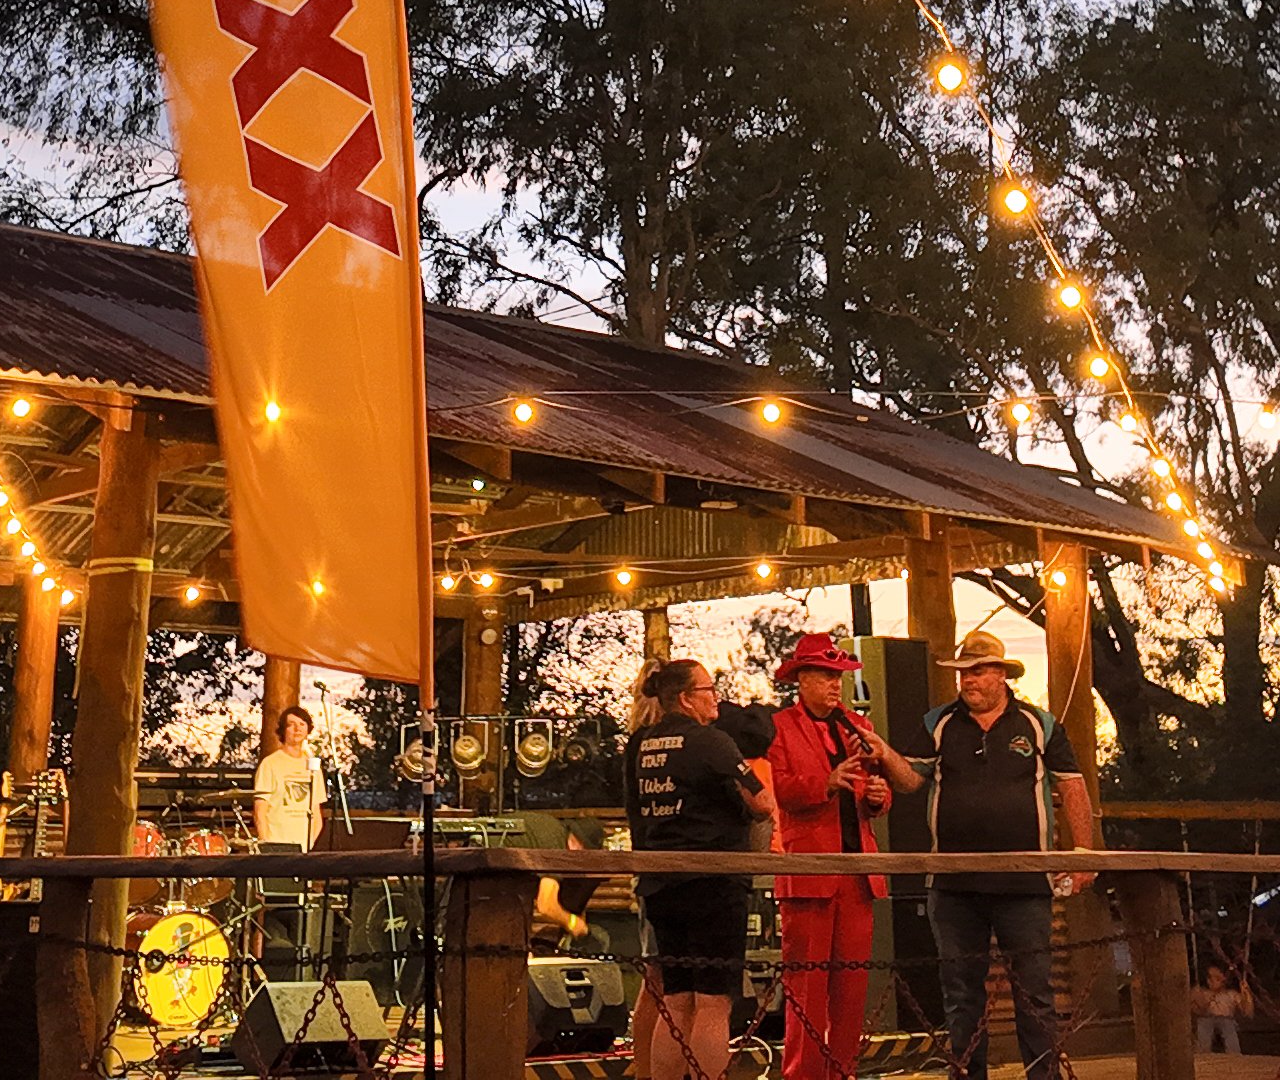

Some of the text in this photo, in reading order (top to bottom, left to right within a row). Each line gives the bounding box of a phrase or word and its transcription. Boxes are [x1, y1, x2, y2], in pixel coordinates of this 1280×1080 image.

[641, 753, 668, 768] STAFF
[644, 776, 677, 794] Work
[651, 799, 683, 816] beer!
